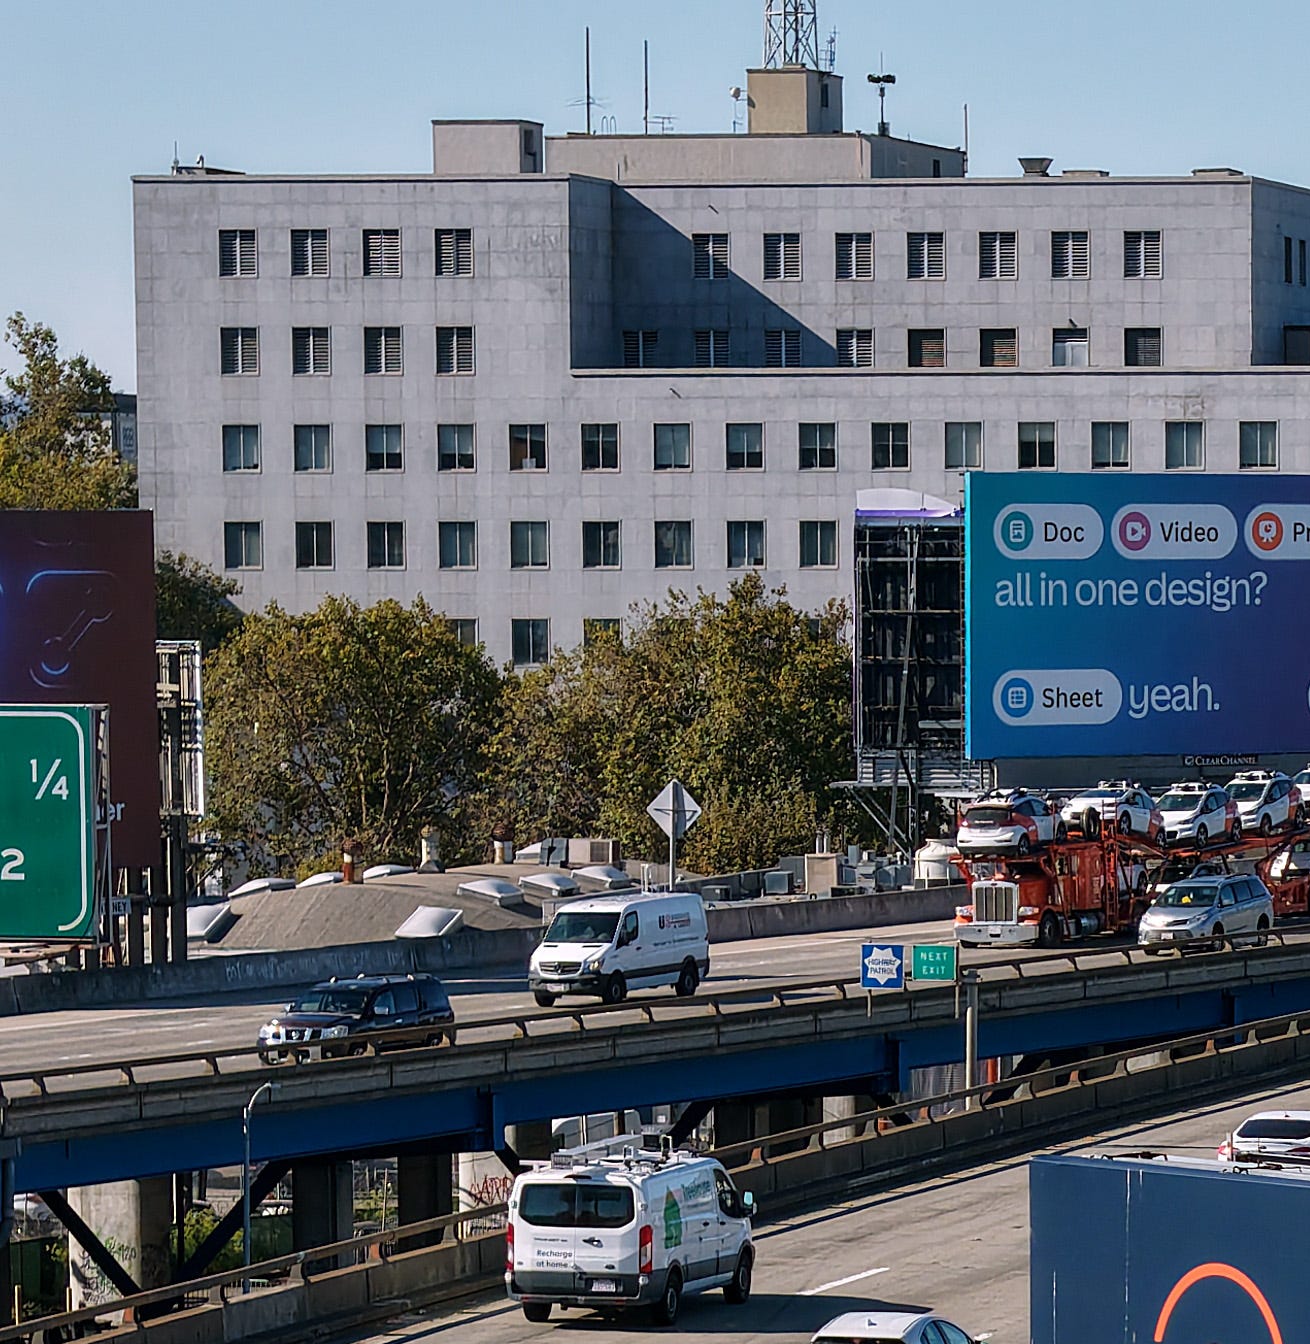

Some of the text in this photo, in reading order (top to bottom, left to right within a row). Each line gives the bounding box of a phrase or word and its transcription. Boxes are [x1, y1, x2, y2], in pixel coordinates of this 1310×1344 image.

[1044, 521, 1085, 543] Doc
[1160, 520, 1219, 543] Video
[995, 571, 1269, 612] all in one design?
[1041, 676, 1220, 719] Sheet yeah.
[29, 758, 70, 801] 1/4
[0, 848, 26, 881] 2
[920, 952, 948, 961] NEXT
[869, 966, 895, 976] PATROL
[922, 966, 946, 976] EXIT
[536, 1249, 573, 1260] Recharge
[536, 1259, 569, 1269] at home
